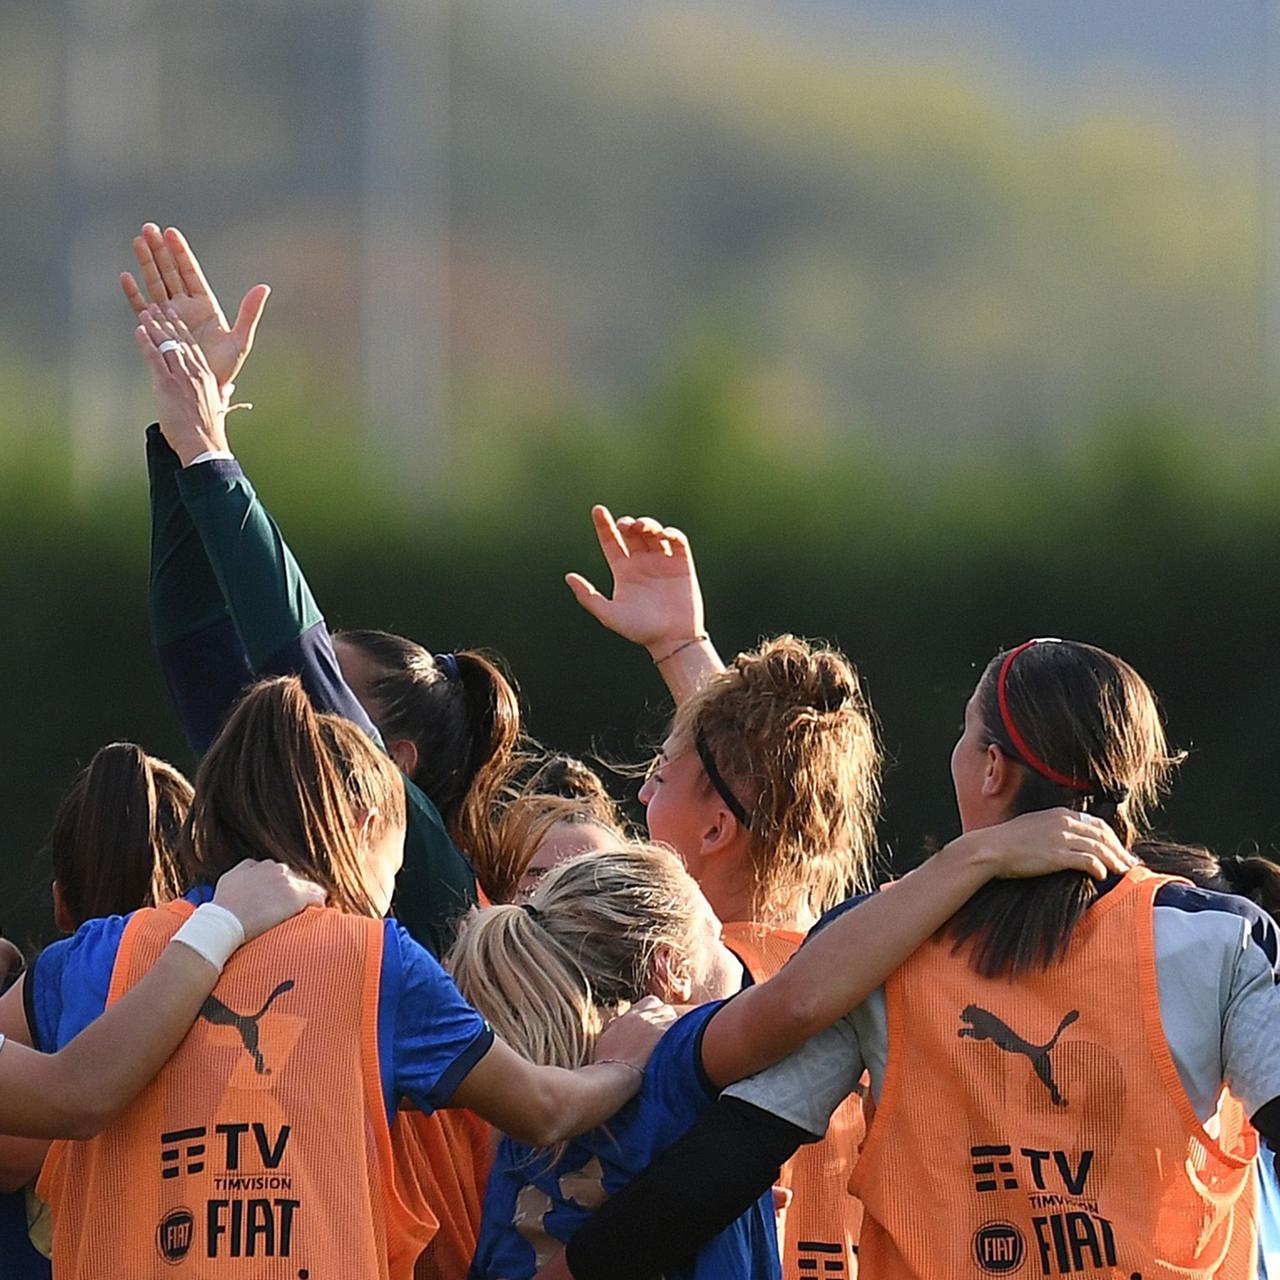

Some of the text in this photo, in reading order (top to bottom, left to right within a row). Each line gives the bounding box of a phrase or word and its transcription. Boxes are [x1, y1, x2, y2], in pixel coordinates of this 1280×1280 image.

[216, 1123, 291, 1170] TV
[214, 1178, 292, 1190] TIMVISION
[1021, 1148, 1094, 1195] TV
[168, 1224, 190, 1250] FIAT
[207, 1199, 300, 1258] FIAT
[984, 1237, 1015, 1261] FIAT
[1032, 1211, 1117, 1275] FIAT
